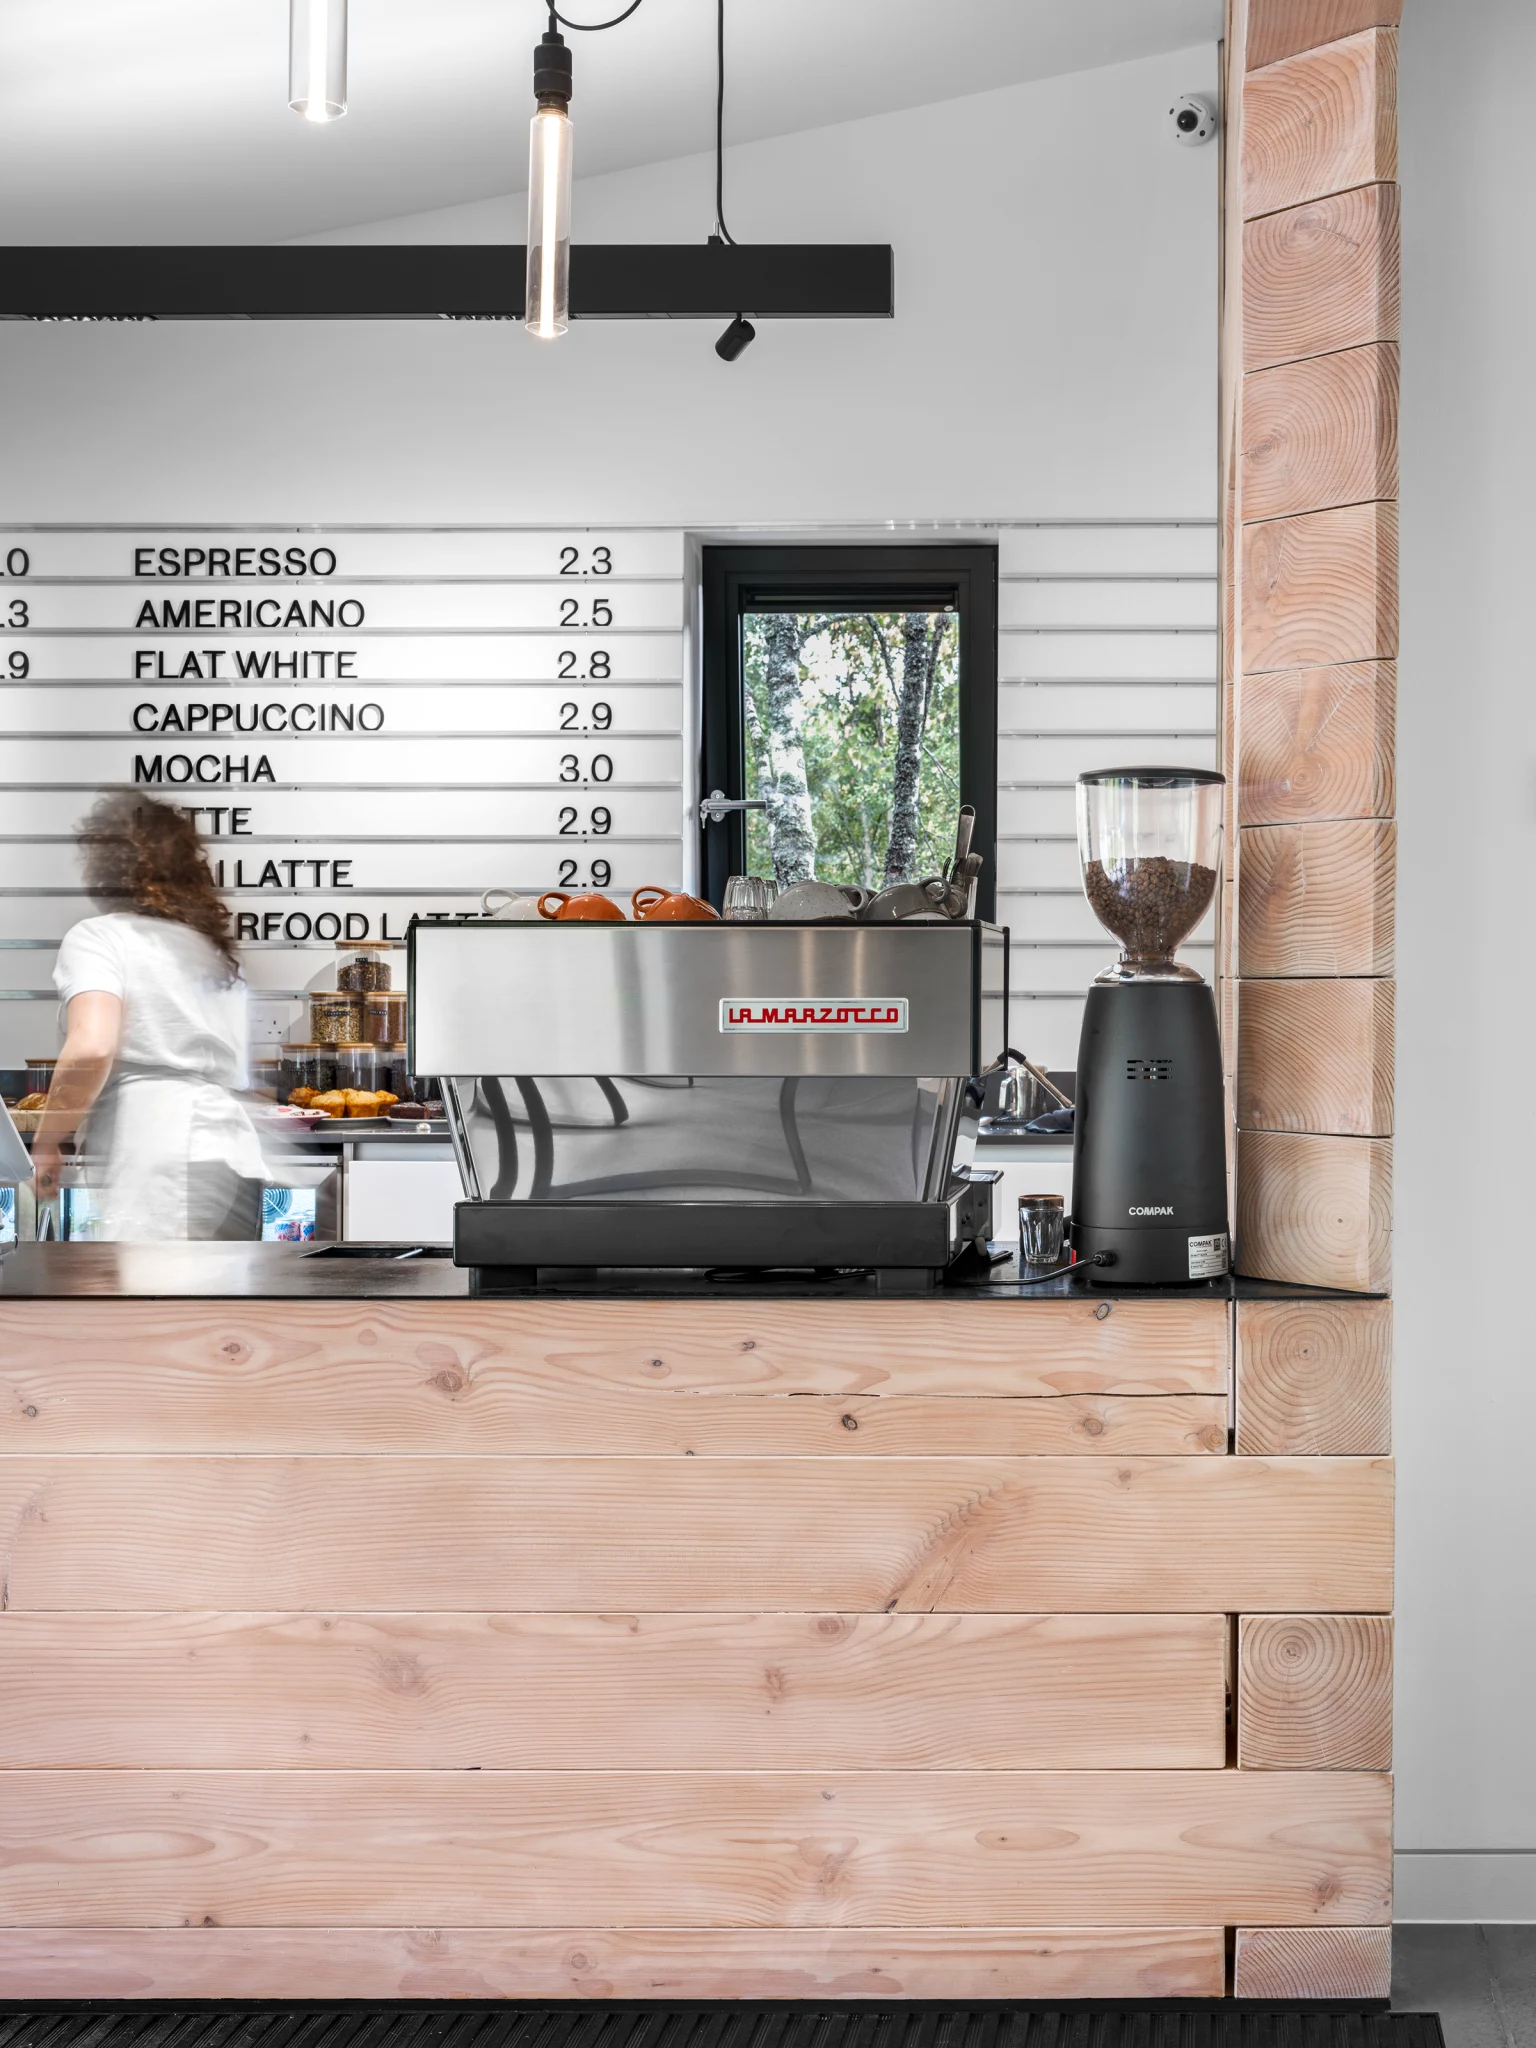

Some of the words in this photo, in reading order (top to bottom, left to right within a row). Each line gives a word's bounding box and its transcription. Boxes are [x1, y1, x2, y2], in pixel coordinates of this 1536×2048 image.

[135, 547, 336, 576] ESPRESSO
[560, 547, 611, 576] 2.3
[136, 599, 364, 628] AMERICANO
[561, 599, 613, 627] 2.5
[135, 651, 225, 678] FLAT
[235, 651, 357, 678] WHITE
[559, 651, 611, 679] 2.8
[133, 703, 384, 731] CAPPUCCINO
[560, 703, 612, 731] 2.9
[135, 755, 275, 782] MOCHA
[560, 755, 613, 782] 3.0
[560, 807, 612, 834] 2.9
[237, 860, 353, 887] LATTE
[559, 860, 612, 888] 2.9
[729, 1008, 752, 1023] LA
[762, 1008, 899, 1023] MARZOCCO
[1128, 1206, 1174, 1216] COMPAK
